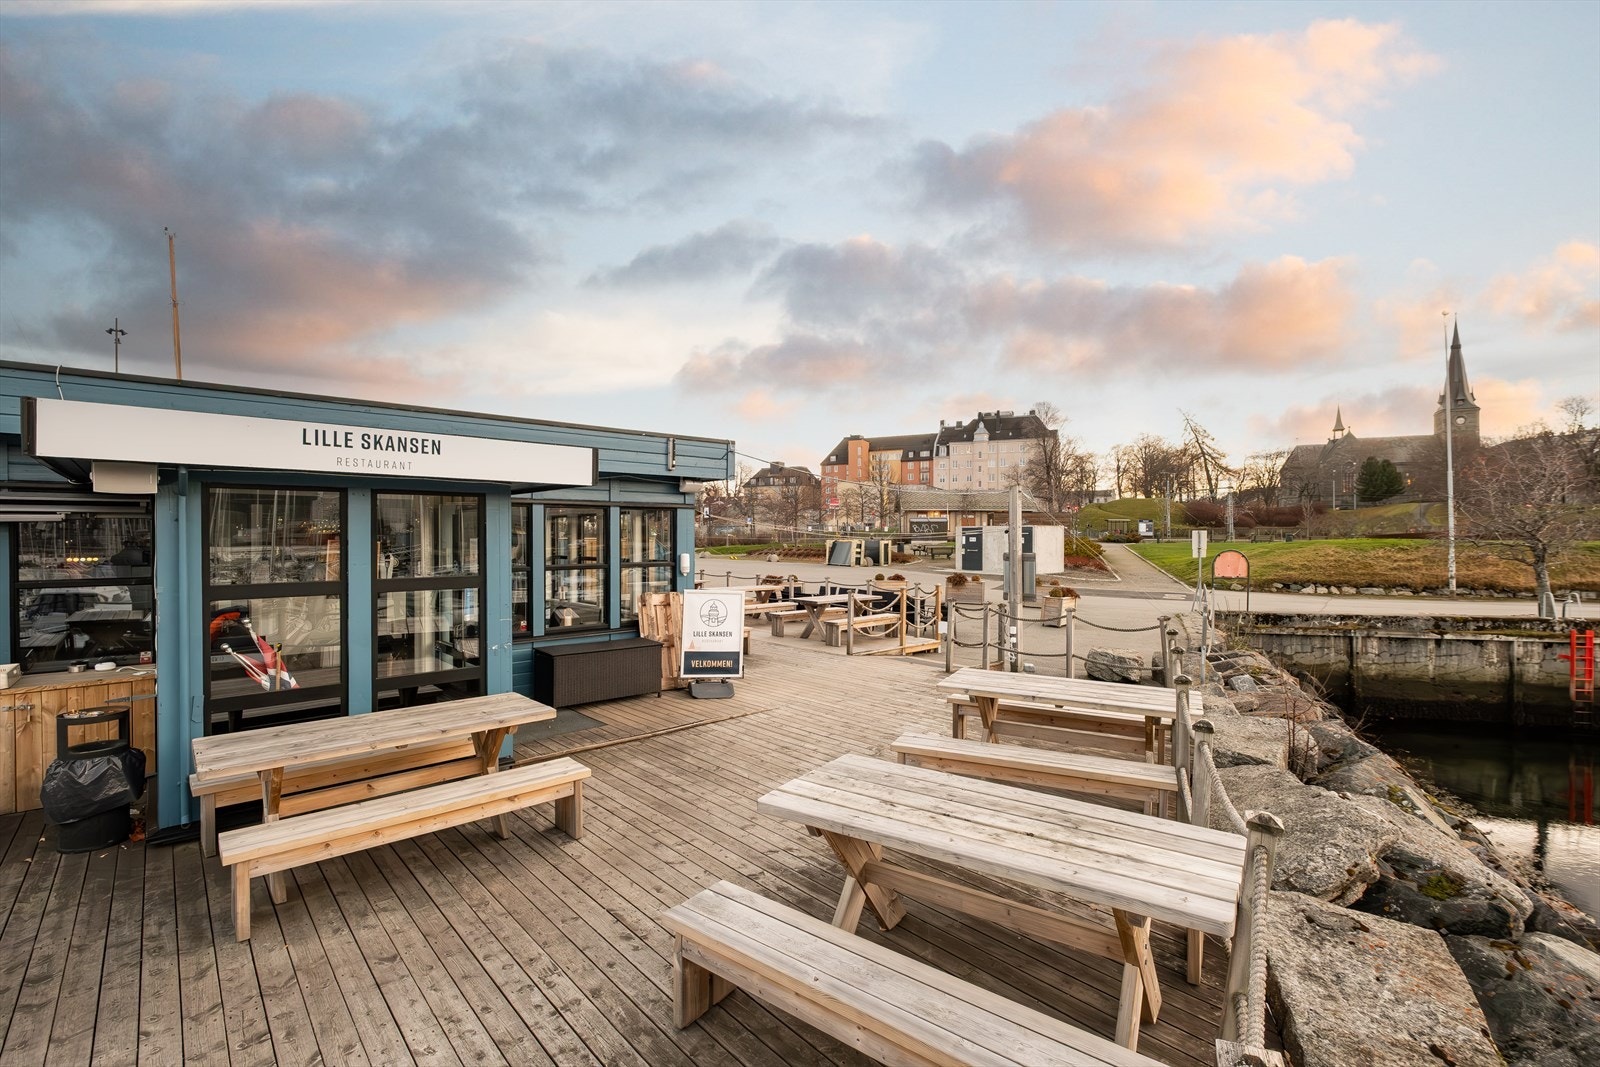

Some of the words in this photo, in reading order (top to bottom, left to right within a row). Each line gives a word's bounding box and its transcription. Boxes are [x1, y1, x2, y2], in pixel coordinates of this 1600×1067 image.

[302, 428, 354, 449] LILLE
[361, 433, 441, 456] SKANSEN
[336, 457, 413, 471] RESTAURANT
[691, 660, 733, 668] VELKOMMEN!
